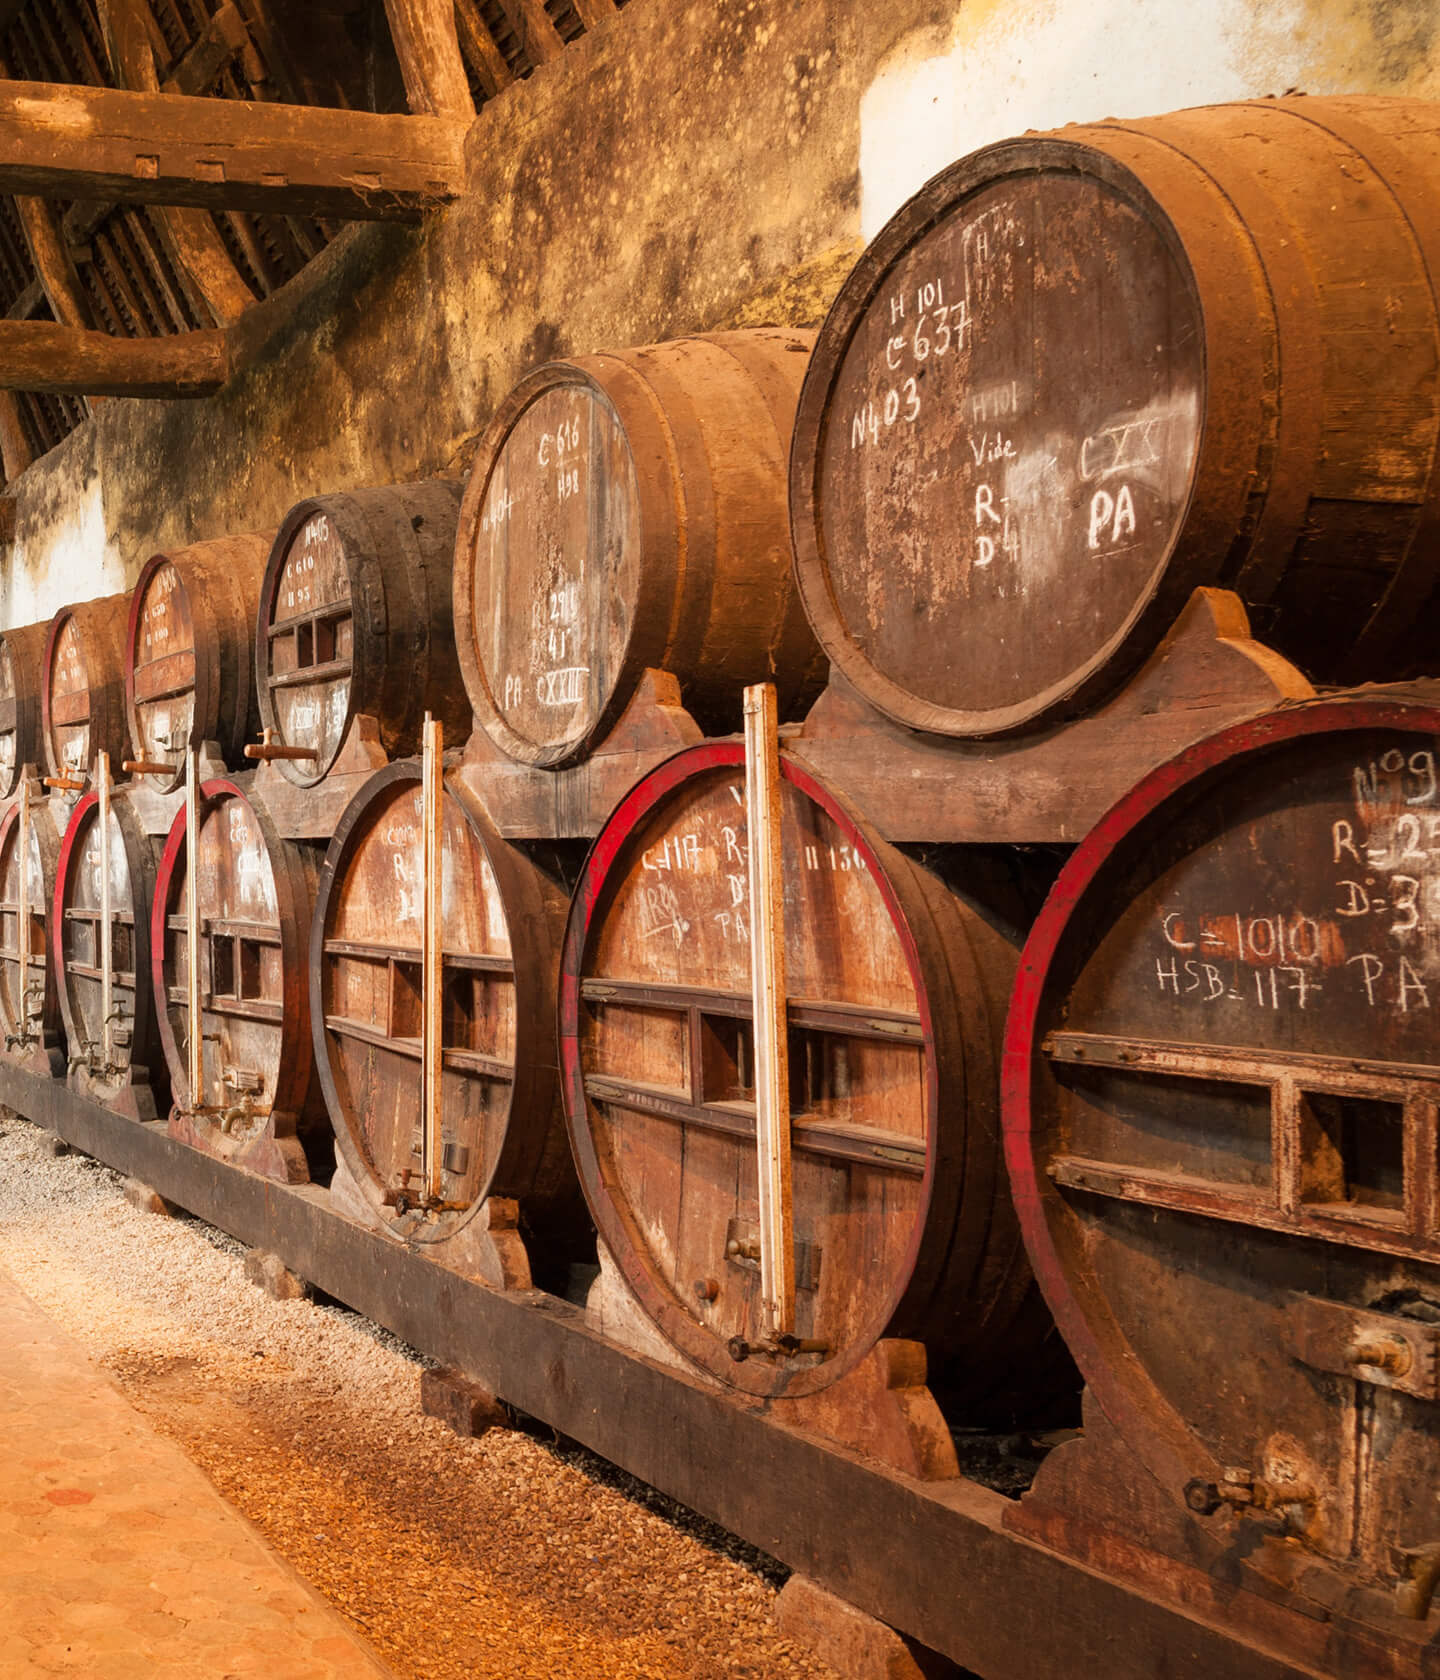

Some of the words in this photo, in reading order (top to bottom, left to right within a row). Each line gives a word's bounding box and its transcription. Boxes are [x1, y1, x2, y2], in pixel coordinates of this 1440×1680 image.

[891, 294, 905, 325] H
[918, 278, 943, 314] 101
[914, 301, 974, 361] 637
[970, 431, 1017, 466] Vide
[1088, 485, 1136, 550] PA
